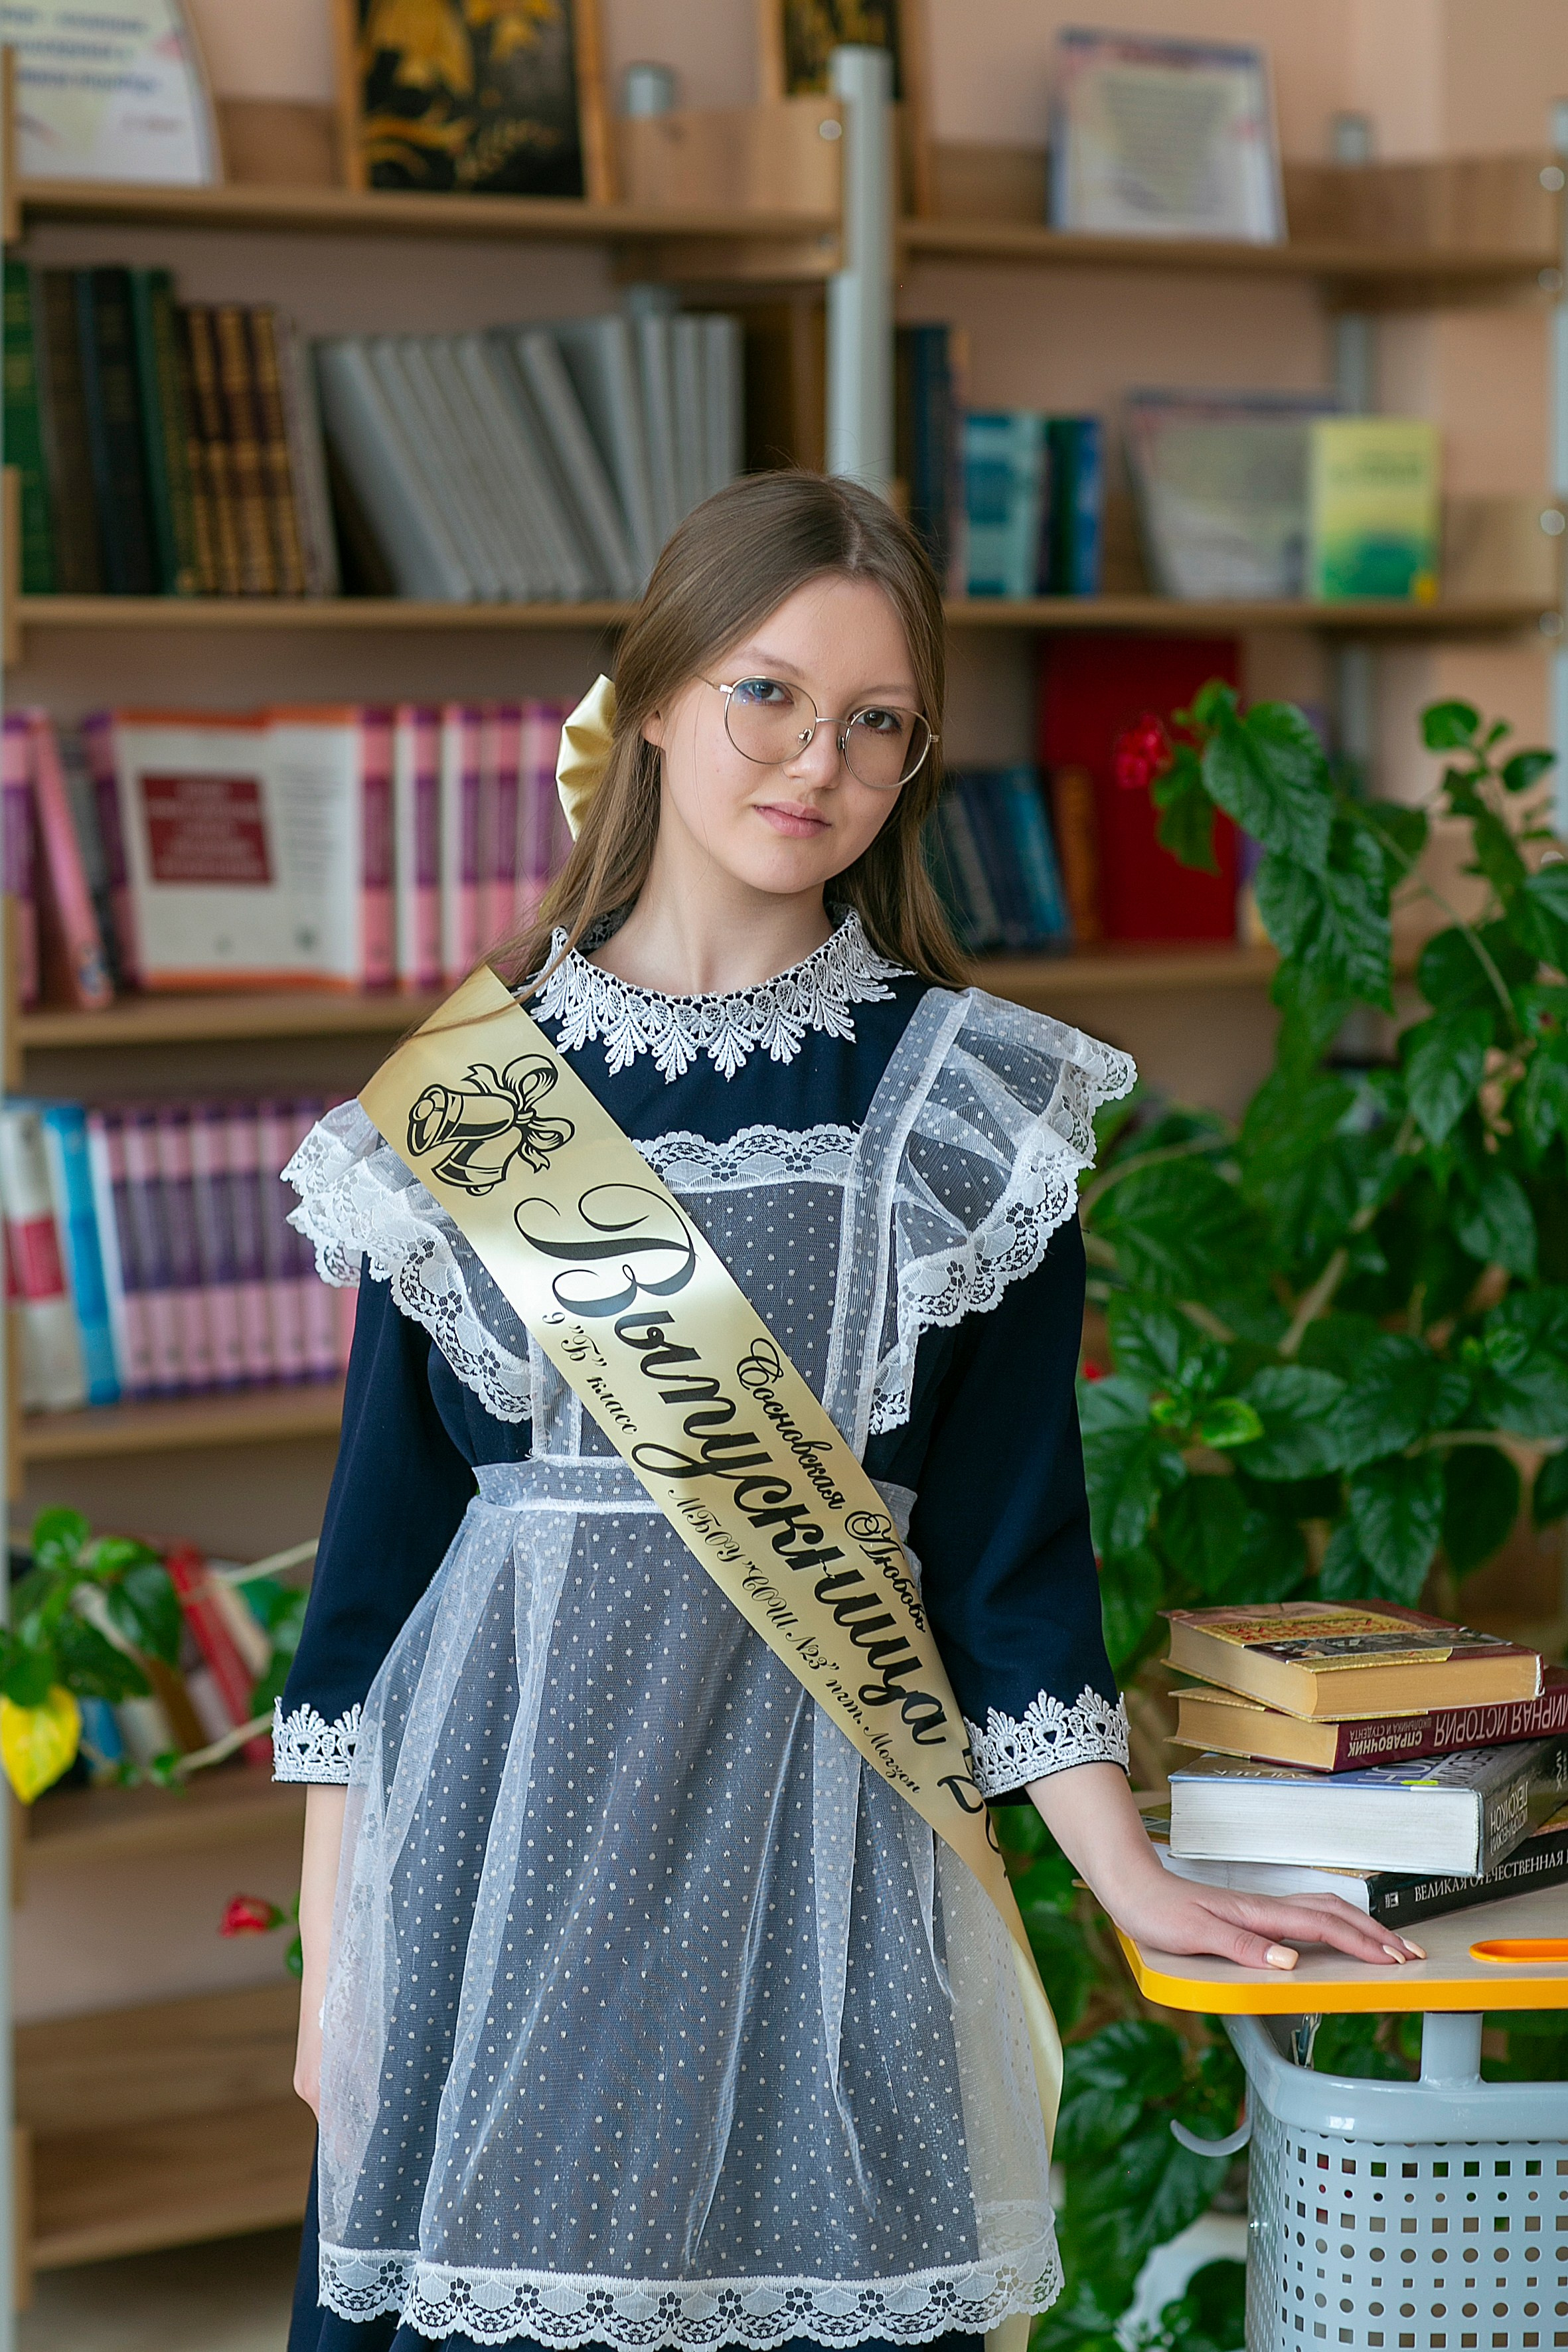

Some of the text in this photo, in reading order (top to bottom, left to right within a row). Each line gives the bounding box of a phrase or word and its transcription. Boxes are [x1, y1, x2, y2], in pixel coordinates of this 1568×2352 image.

[542, 1312, 565, 1325] 9
[586, 1376, 637, 1435] класс
[514, 1183, 947, 1746] Выпускница
[737, 1338, 926, 1632] Сосновская Любовь
[668, 1490, 742, 1563] МБОУ
[826, 1679, 862, 1725] пгт.
[864, 1726, 921, 1794] Могзон
[1348, 1731, 1422, 1757] СПРАВОЧНИК
[1350, 1725, 1385, 1739] СТУДЕНТА
[1393, 1717, 1432, 1733] ШКОЛЬНИКА
[1434, 1706, 1508, 1747] ИСТОРИЯ
[1490, 1780, 1528, 1836] ЛЕКСИКОН
[1415, 1876, 1468, 1902] ВЕЛИКАЯ
